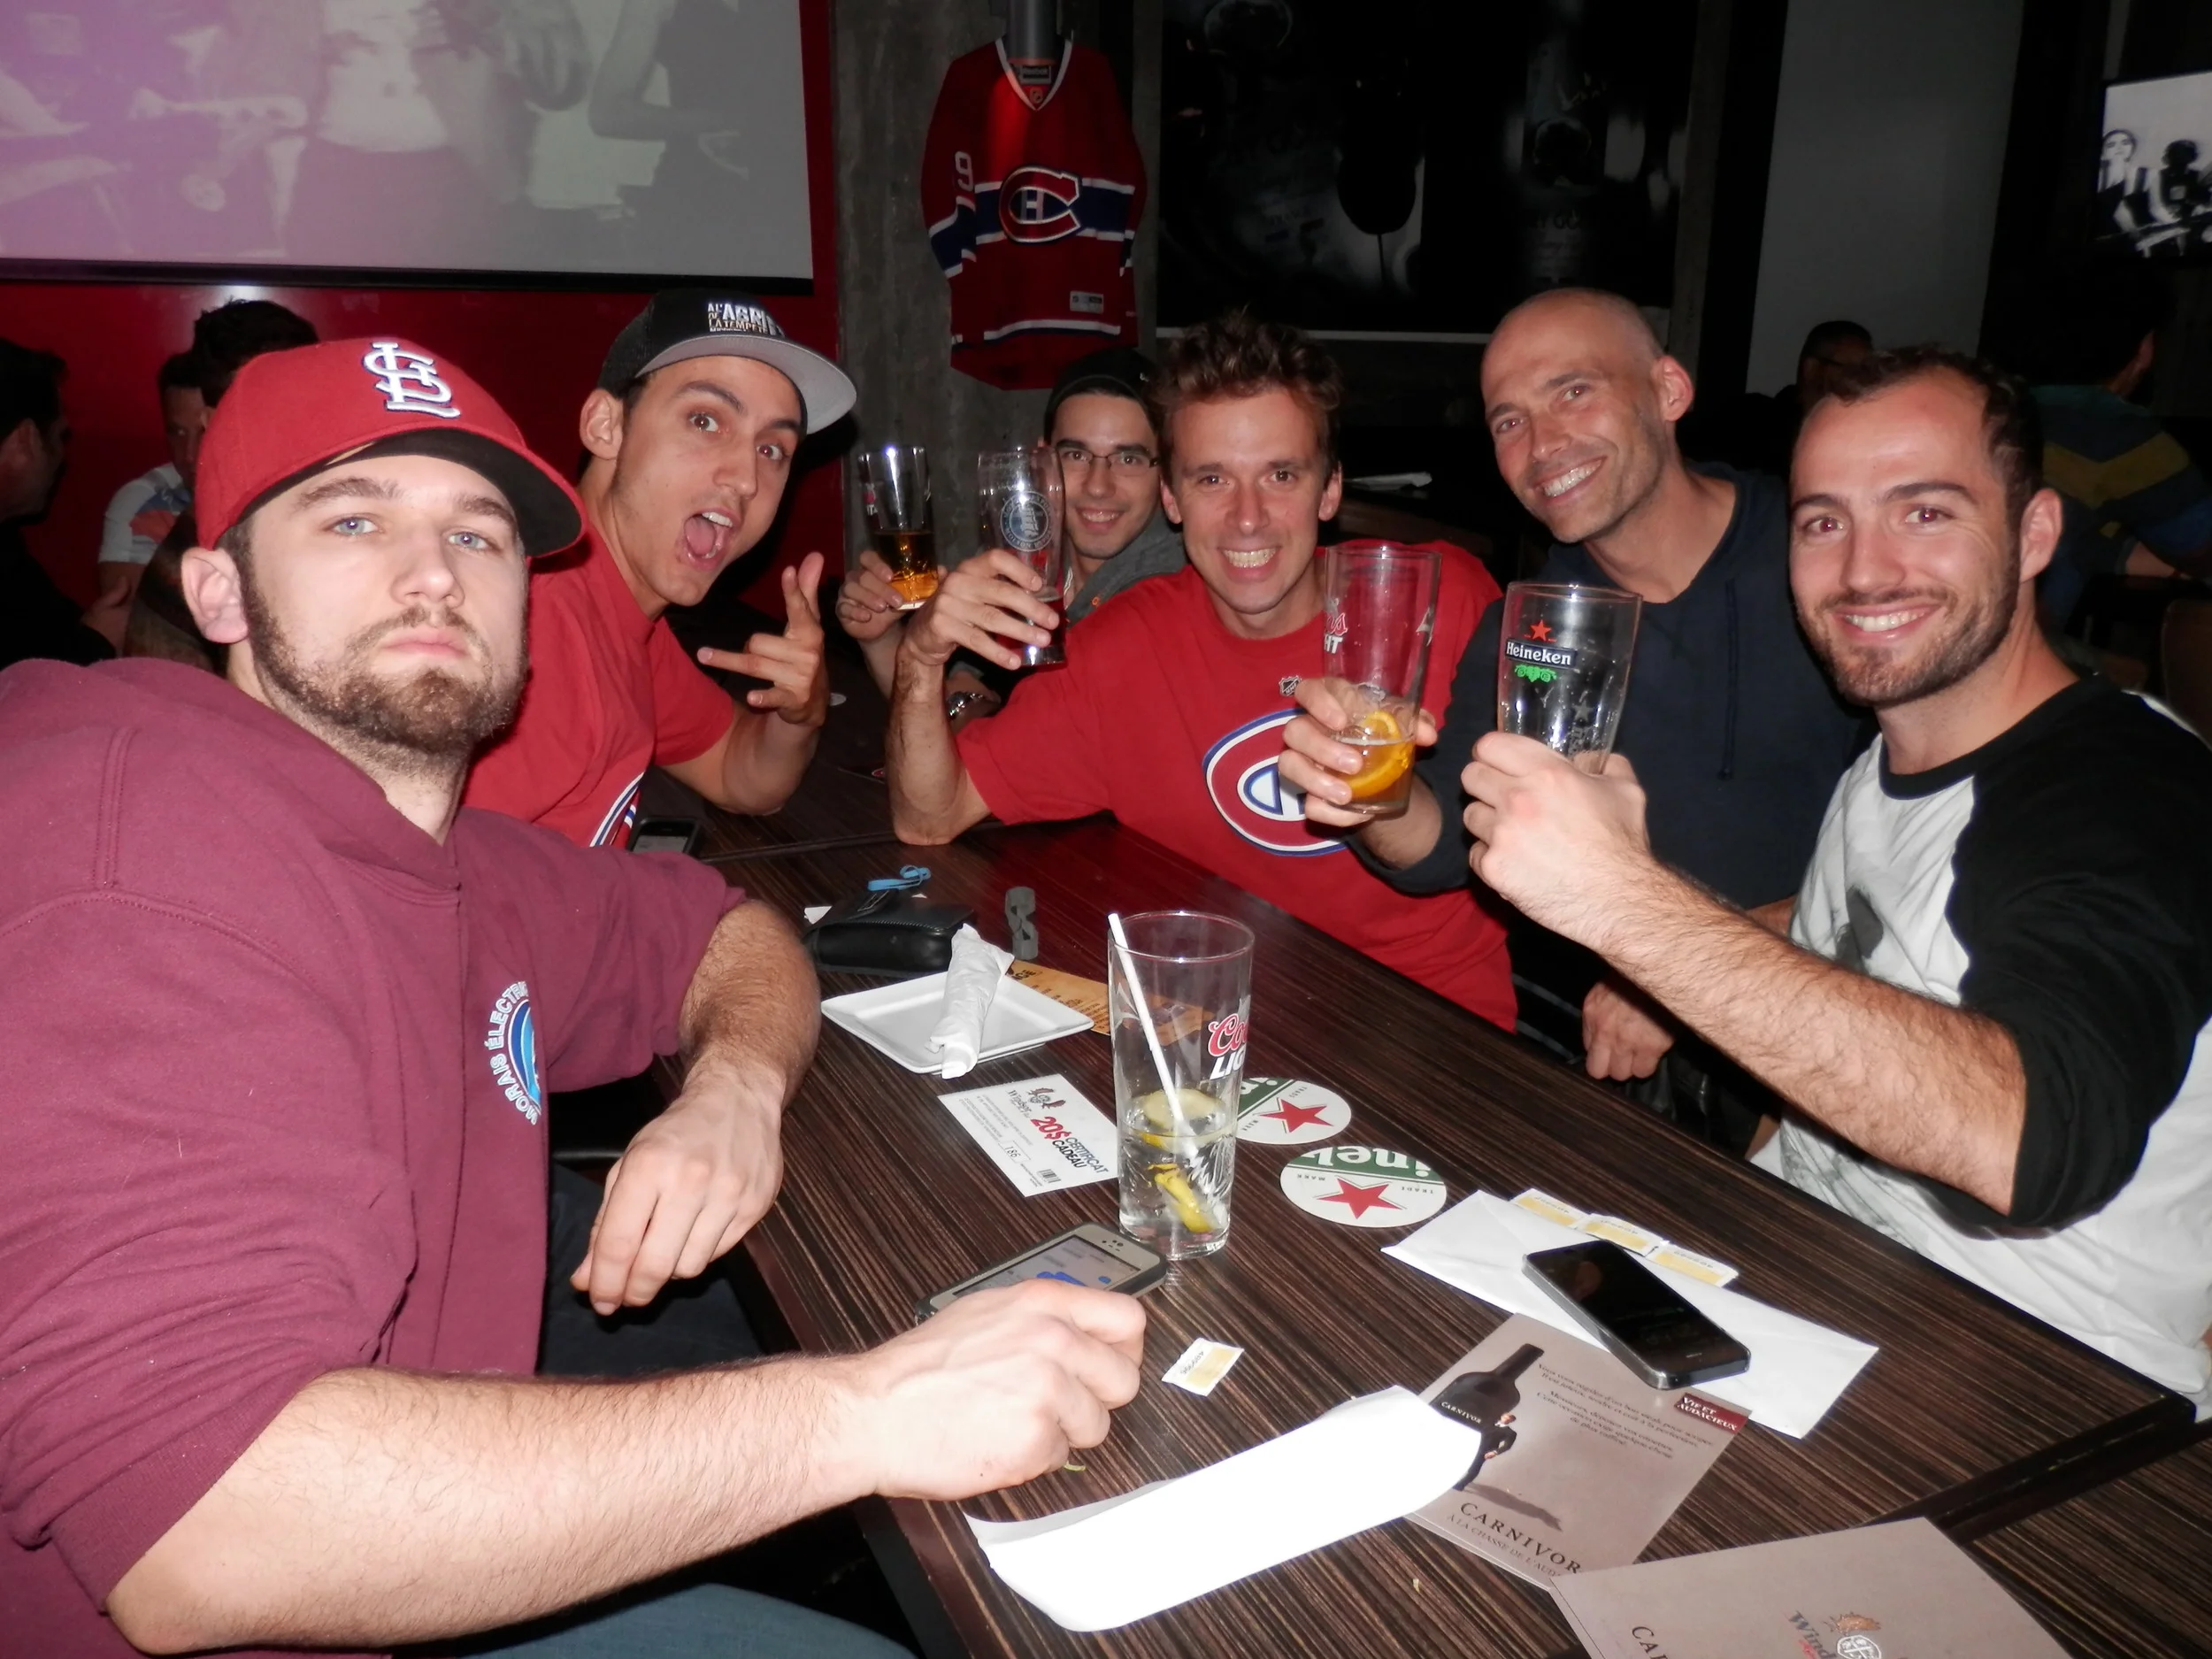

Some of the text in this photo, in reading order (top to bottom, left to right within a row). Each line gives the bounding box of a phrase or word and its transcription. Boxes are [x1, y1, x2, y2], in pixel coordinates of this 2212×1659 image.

[1506, 641, 1571, 665] Heineken
[1030, 1116, 1072, 1140] 20$
[1052, 1140, 1087, 1168] CADEAU
[1440, 1401, 1482, 1424] CARNIVOR
[1677, 1403, 1738, 1431] AUDACIEUX
[1683, 1397, 1717, 1415] VIF ET
[1460, 1502, 1582, 1575] CARNIVOR
